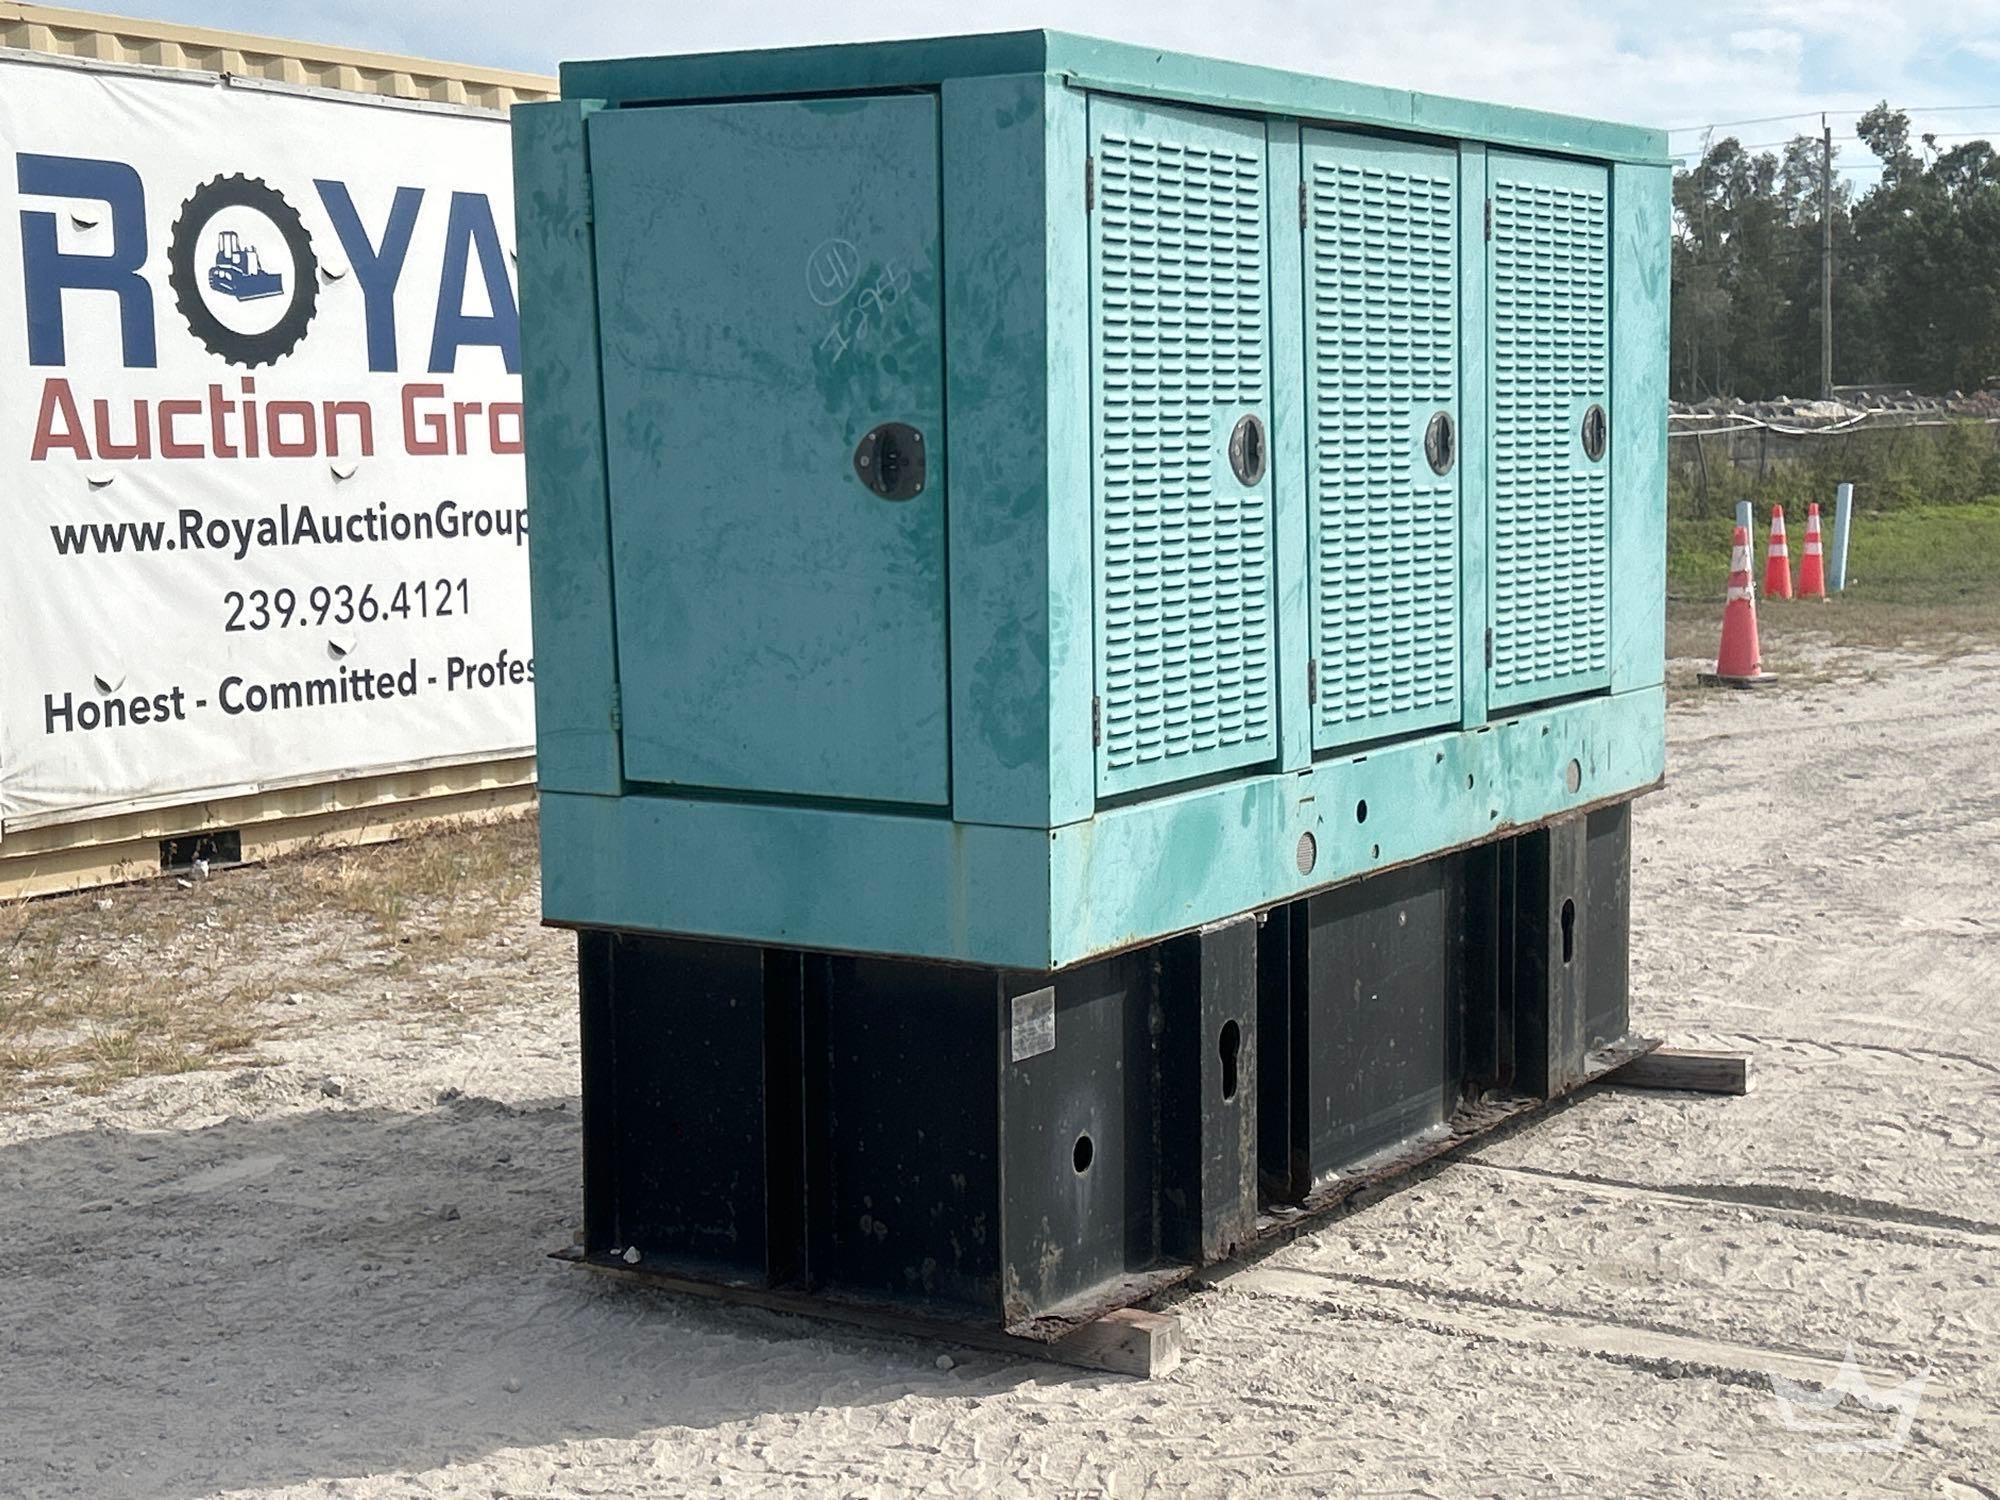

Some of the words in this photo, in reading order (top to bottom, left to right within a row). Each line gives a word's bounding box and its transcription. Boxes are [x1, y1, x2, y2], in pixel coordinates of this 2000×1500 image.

[31, 376, 375, 461] Auction
[402, 383, 524, 456] Gro
[224, 577, 471, 632] 239.936.4121
[44, 686, 186, 734] Honest
[218, 659, 417, 716] Committed
